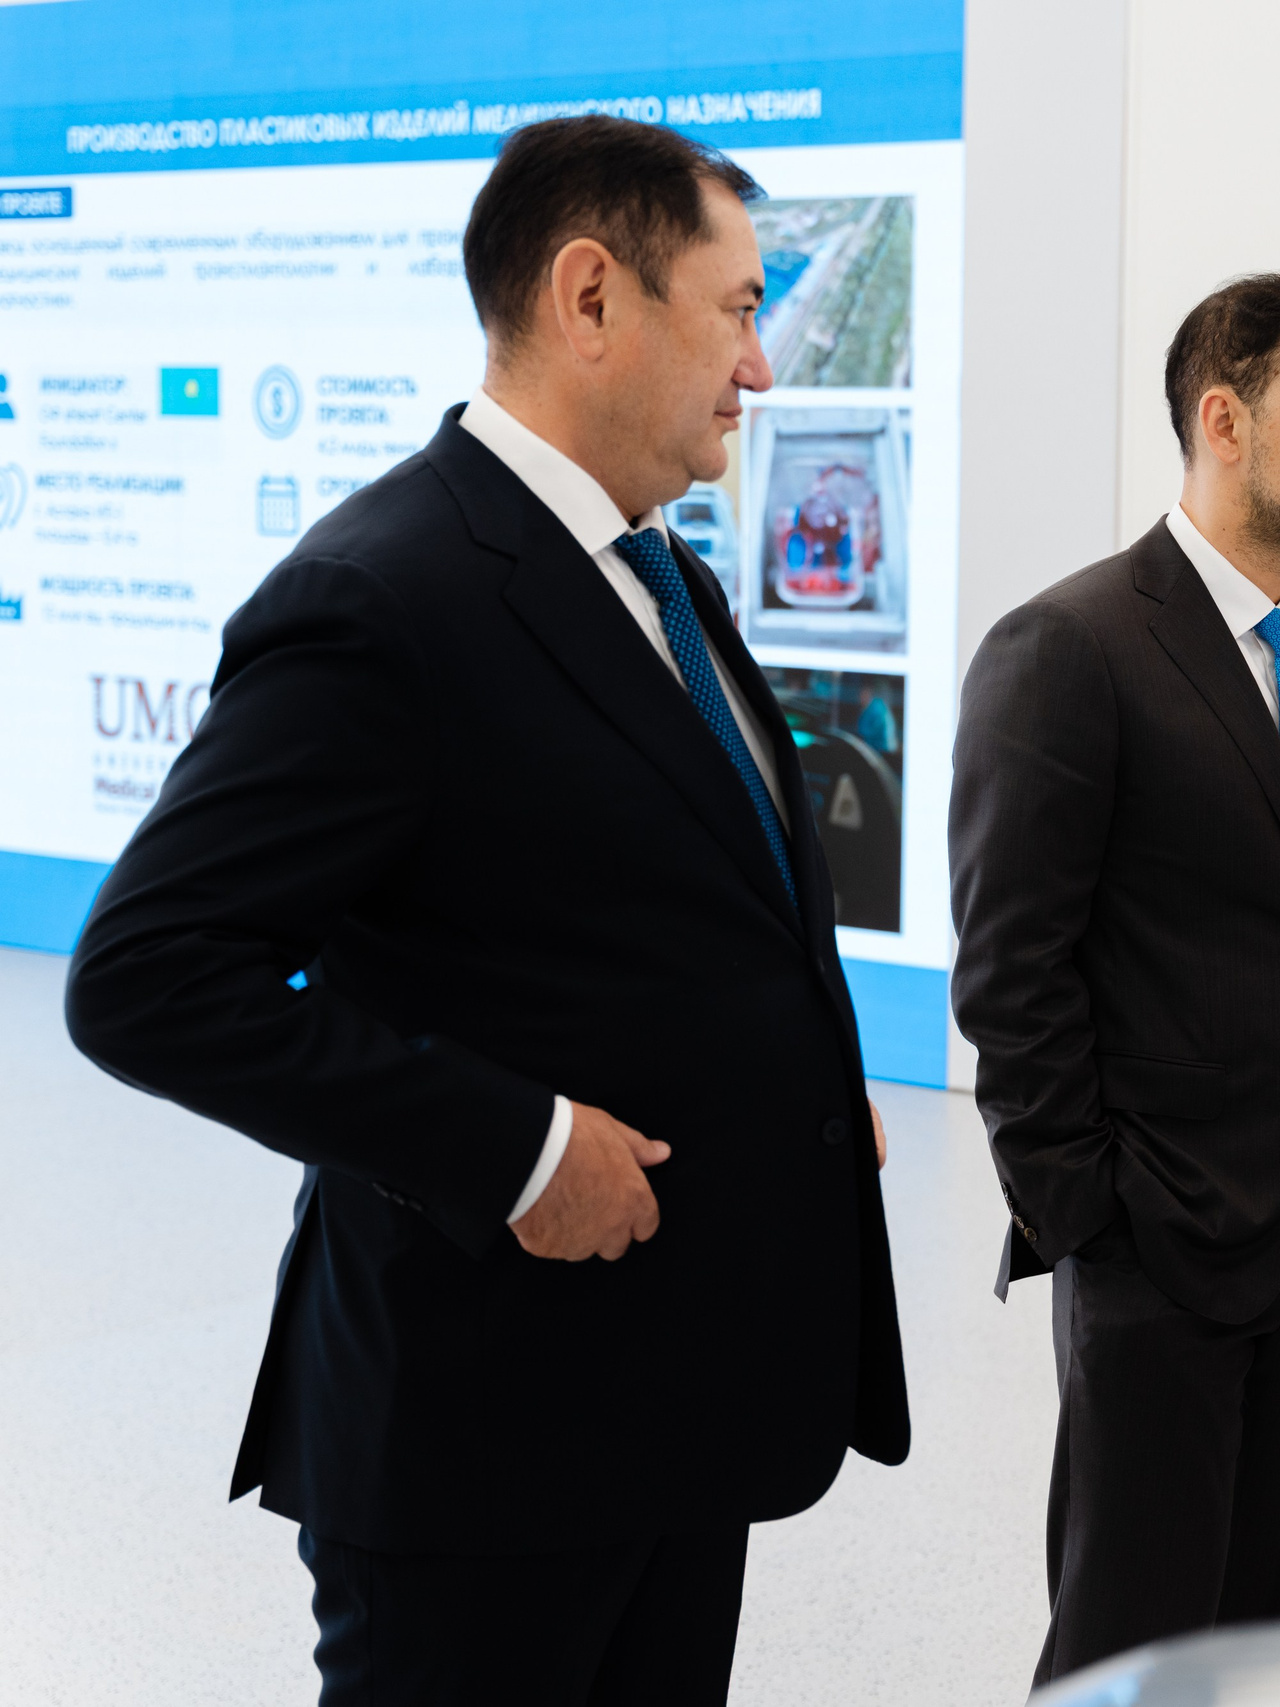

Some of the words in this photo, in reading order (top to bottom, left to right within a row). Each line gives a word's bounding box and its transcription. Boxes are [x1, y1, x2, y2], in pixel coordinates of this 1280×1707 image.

[67, 118, 216, 153] ПРОИЗВОДСТВО
[219, 111, 370, 147] ПЛАСТИКОВЫХ
[373, 100, 470, 142] ИЗДЕЛИЙ
[666, 88, 822, 125] НАЗНАЧЕНИЯ
